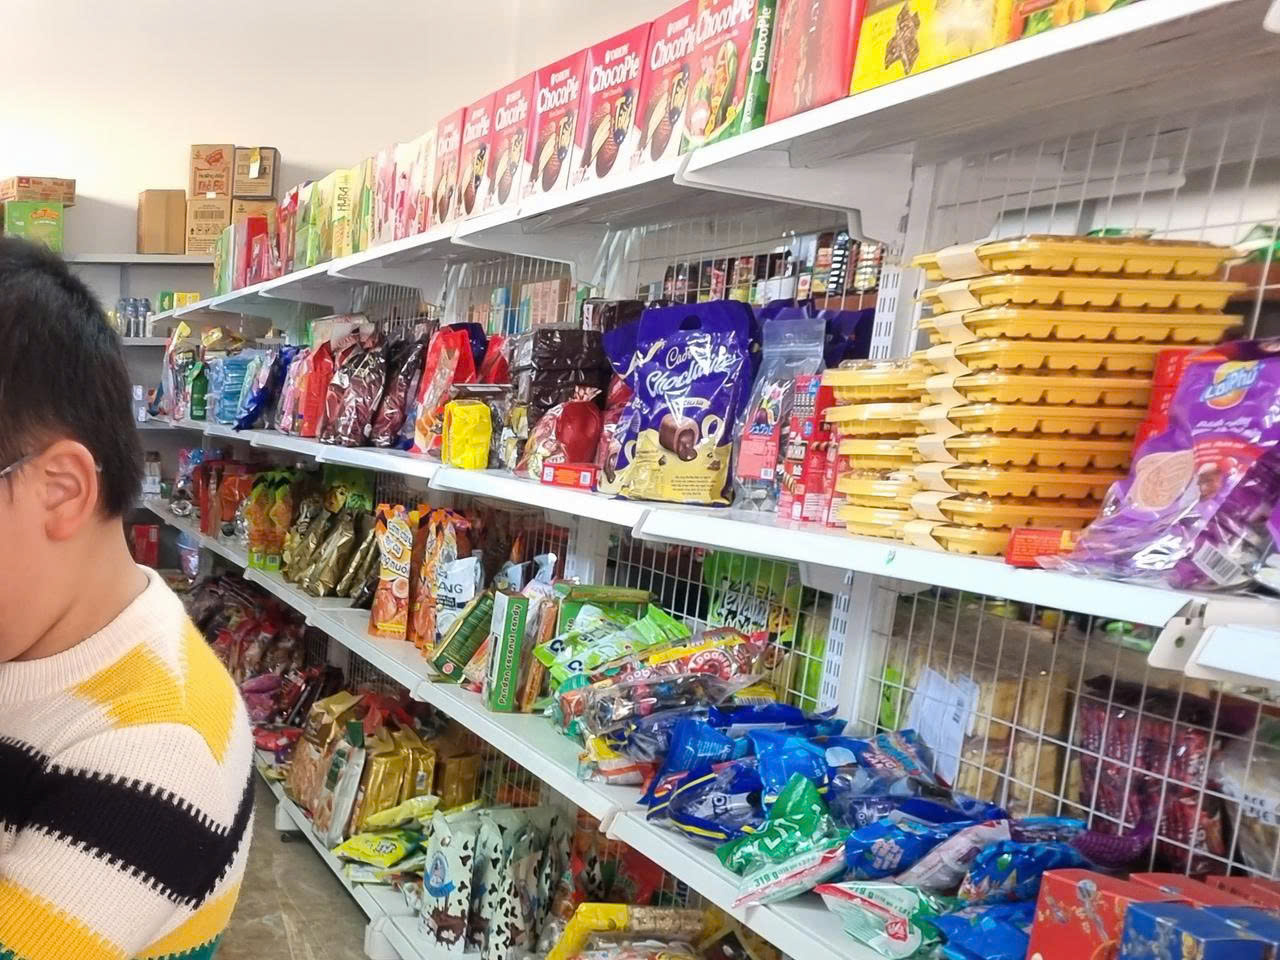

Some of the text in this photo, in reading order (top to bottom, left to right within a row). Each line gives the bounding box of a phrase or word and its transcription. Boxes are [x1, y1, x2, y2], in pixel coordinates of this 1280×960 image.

[751, 6, 771, 73] ChocoPie
[536, 76, 580, 114] ChocoPie
[588, 52, 641, 94] ChocoPie
[499, 604, 522, 704] Pandan coconut candy
